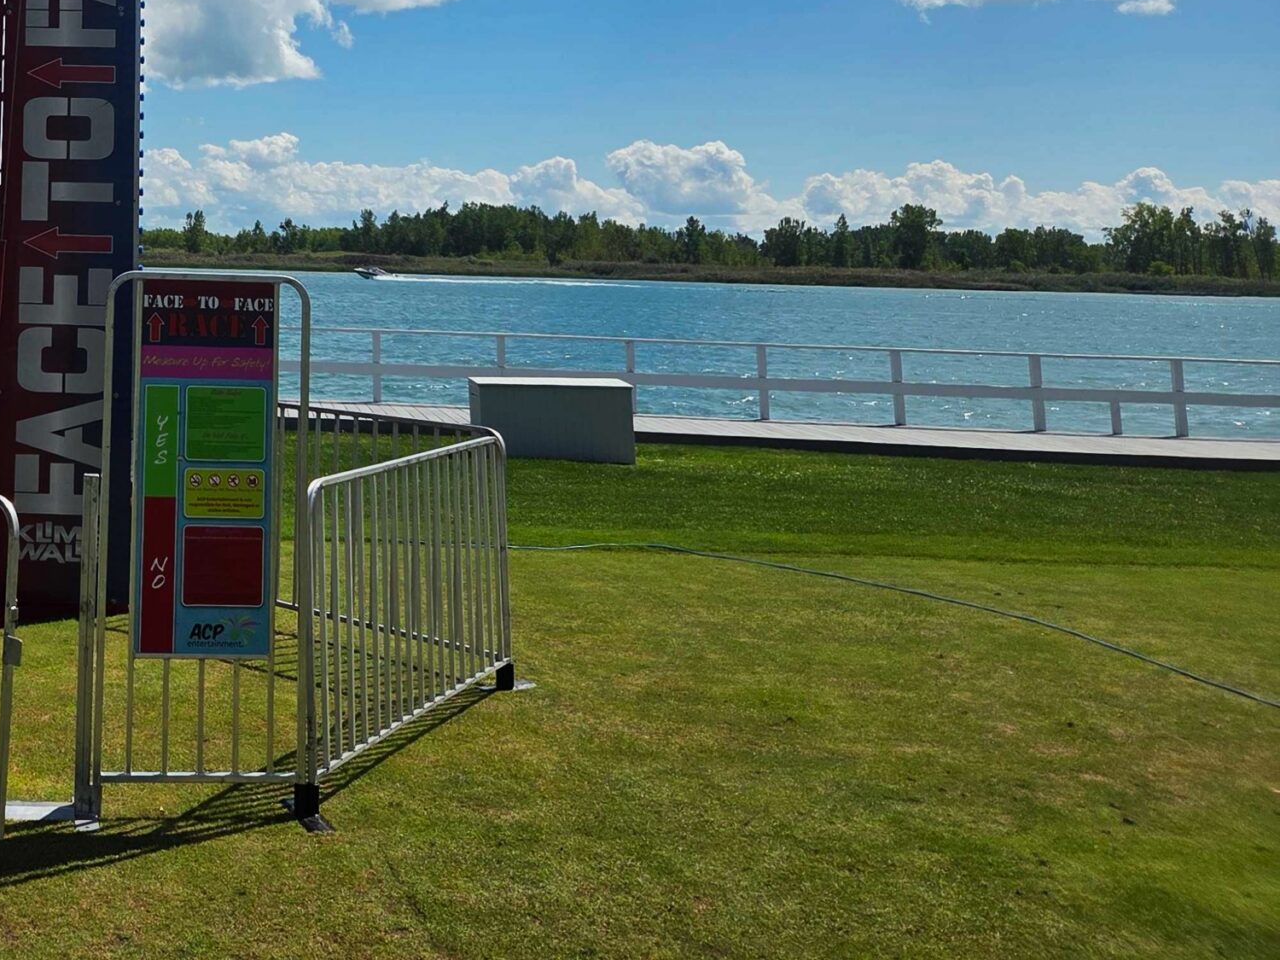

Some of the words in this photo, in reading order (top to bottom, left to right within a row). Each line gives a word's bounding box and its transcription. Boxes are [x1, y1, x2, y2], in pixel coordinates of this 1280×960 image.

[21, 97, 115, 220] TO
[143, 294, 184, 309] FACE
[198, 295, 220, 310] TO
[233, 297, 274, 312] FACE
[168, 311, 246, 338] RACE
[192, 355, 208, 371] Up
[211, 357, 230, 368] For
[15, 266, 113, 515] FACE
[153, 415, 169, 465] YES
[19, 521, 82, 544] KLIM
[150, 556, 169, 589] NO
[189, 623, 225, 640] ACP
